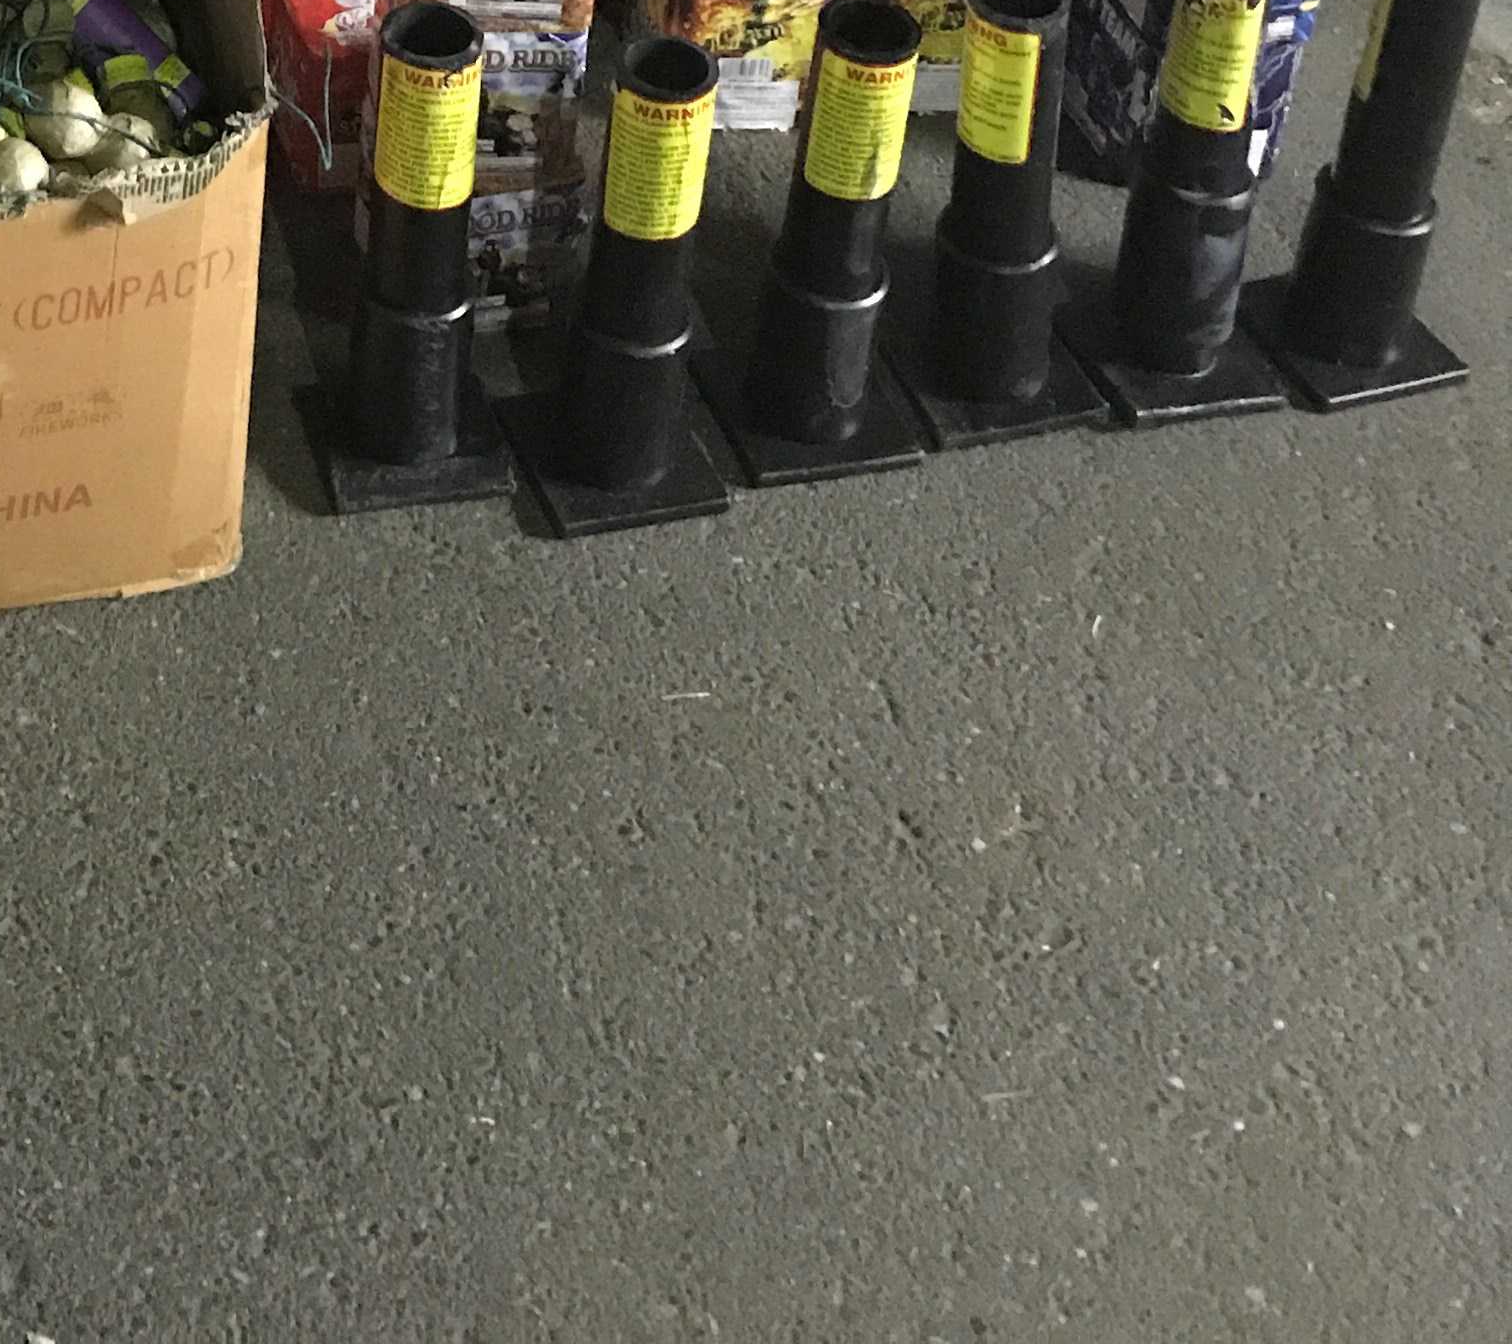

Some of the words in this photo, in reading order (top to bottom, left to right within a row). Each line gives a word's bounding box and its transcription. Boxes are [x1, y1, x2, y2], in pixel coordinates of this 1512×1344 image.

[508, 49, 578, 74] RIDE
[846, 65, 906, 84] WARN
[633, 101, 710, 121] WARNIN
[13, 246, 237, 334] (COMPACT)
